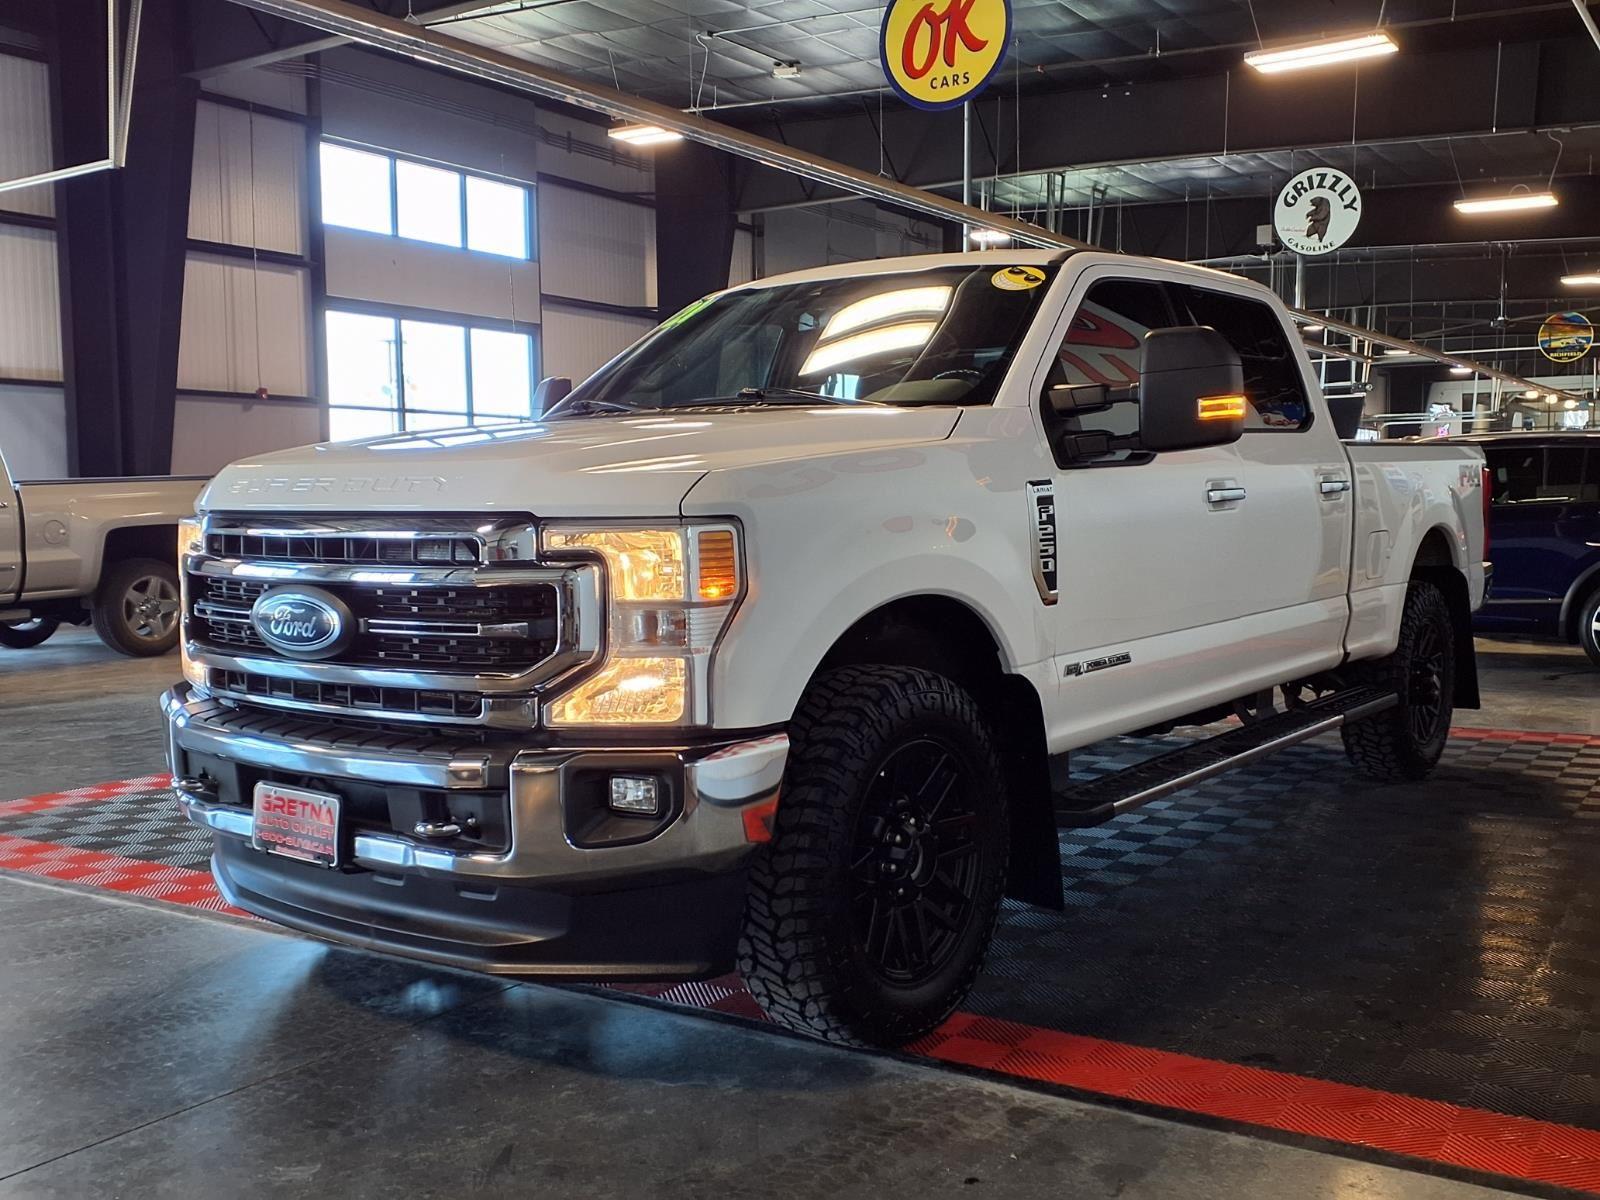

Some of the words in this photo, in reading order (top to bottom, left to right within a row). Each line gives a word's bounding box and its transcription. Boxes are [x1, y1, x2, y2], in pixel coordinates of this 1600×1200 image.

[902, 0, 989, 80] OK
[930, 72, 970, 89] CARS
[1283, 172, 1358, 212] GRIZZLY
[1287, 237, 1335, 252] GASOLINE
[230, 476, 336, 494] SUPER
[342, 476, 448, 494] DUTY
[270, 605, 317, 638] Ford
[263, 794, 334, 825] GRETNA
[257, 815, 289, 830] AUTO
[292, 821, 334, 840] OUTLET
